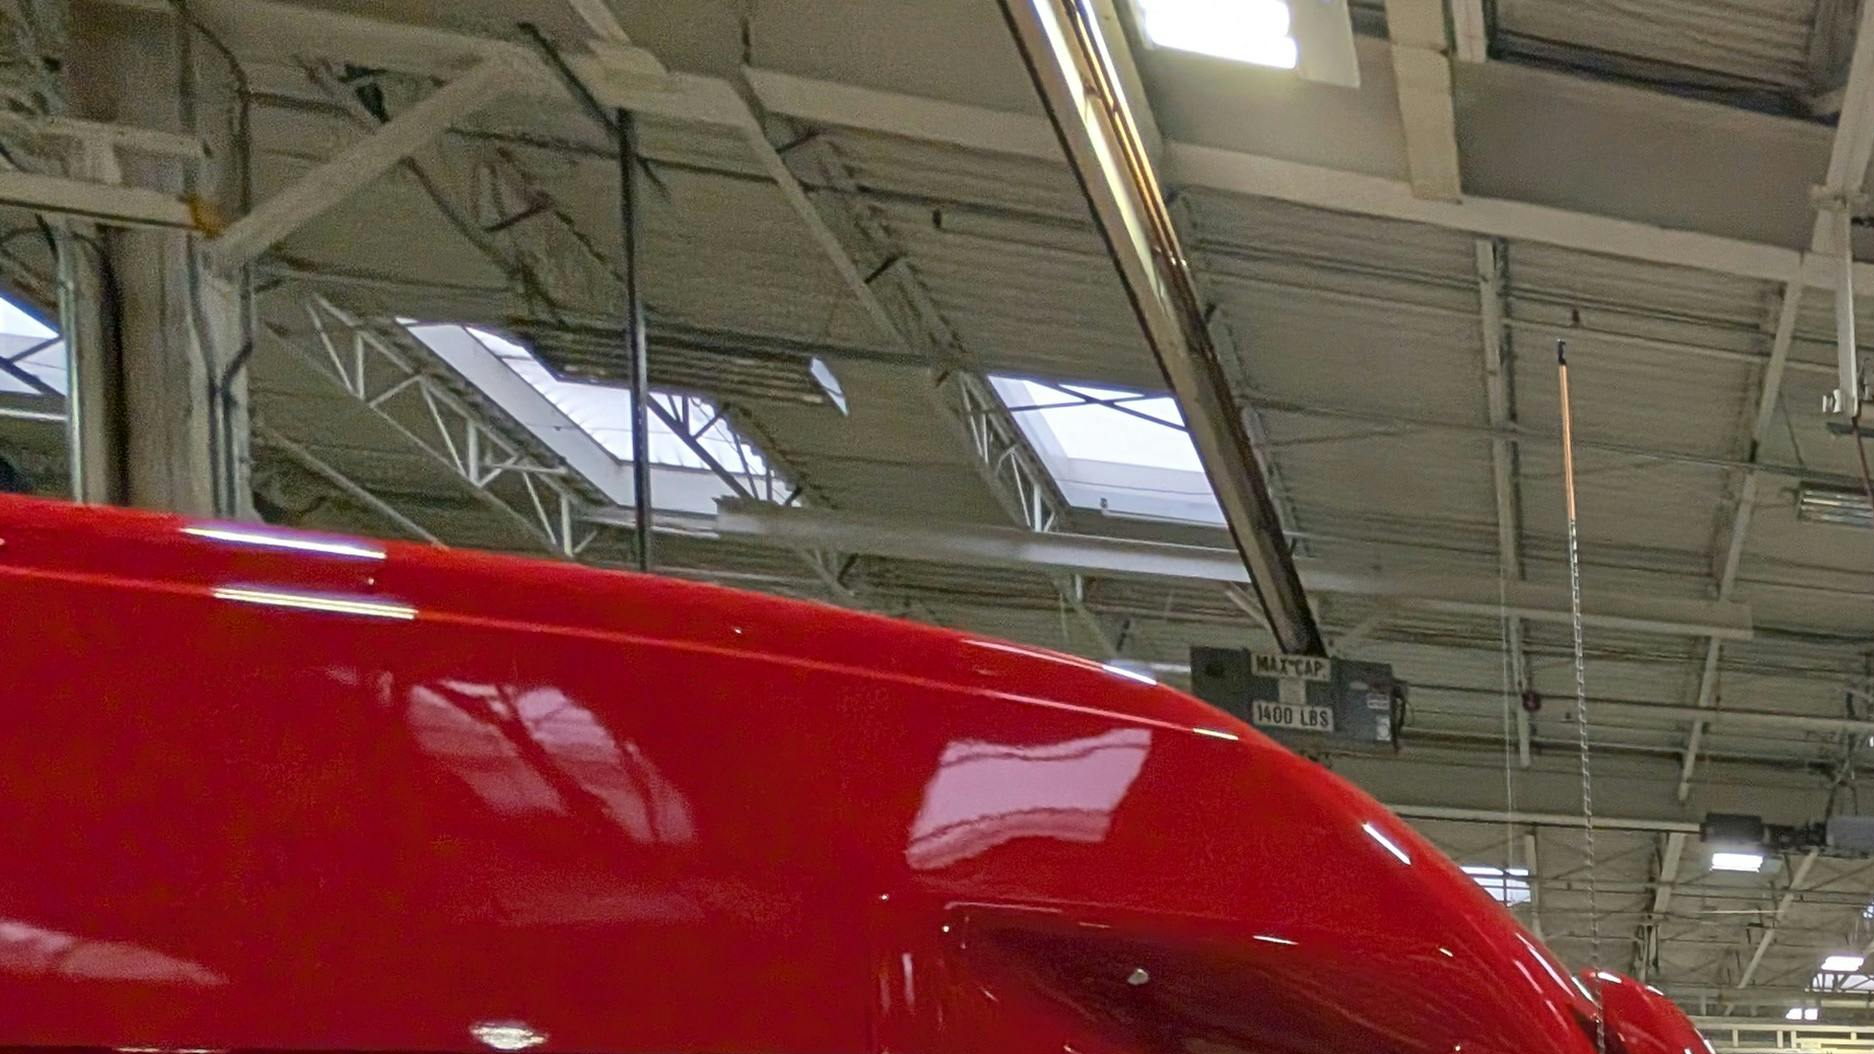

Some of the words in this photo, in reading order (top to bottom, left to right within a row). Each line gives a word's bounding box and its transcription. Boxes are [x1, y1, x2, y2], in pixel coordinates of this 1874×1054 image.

[1257, 655, 1290, 676] MAX
[1257, 704, 1293, 725] 1400
[1300, 707, 1329, 727] LBS
